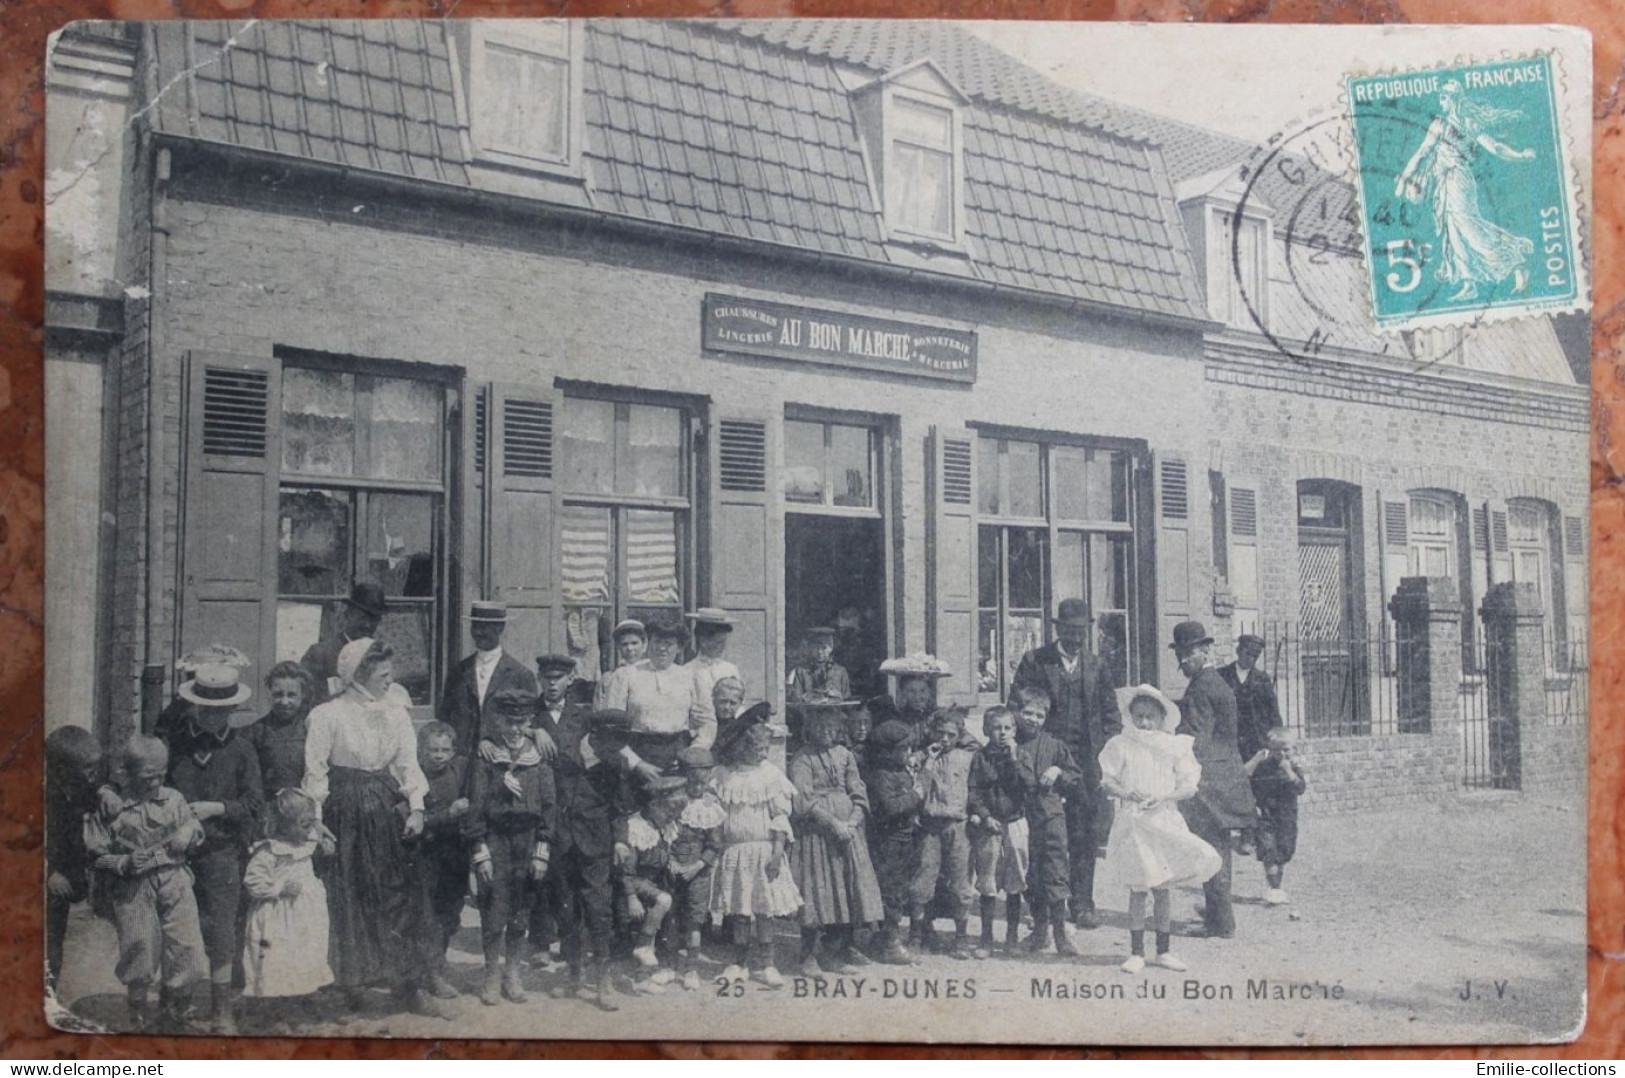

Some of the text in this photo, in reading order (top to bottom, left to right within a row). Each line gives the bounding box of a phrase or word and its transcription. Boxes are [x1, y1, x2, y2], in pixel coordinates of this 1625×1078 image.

[1465, 65, 1543, 88] FRANÇAISE
[1541, 206, 1566, 286] POSTES
[714, 307, 778, 327] CHAUSSURES
[718, 327, 774, 344] LINGERIE
[779, 318, 802, 347] AU
[808, 321, 841, 351] BON
[913, 336, 970, 355] BONNETERIE
[918, 353, 970, 370] MERCERIE
[793, 978, 977, 998] BRAY-DUNES
[1031, 978, 1124, 999] Maison
[1135, 978, 1166, 999] du
[1183, 979, 1234, 999] Bon
